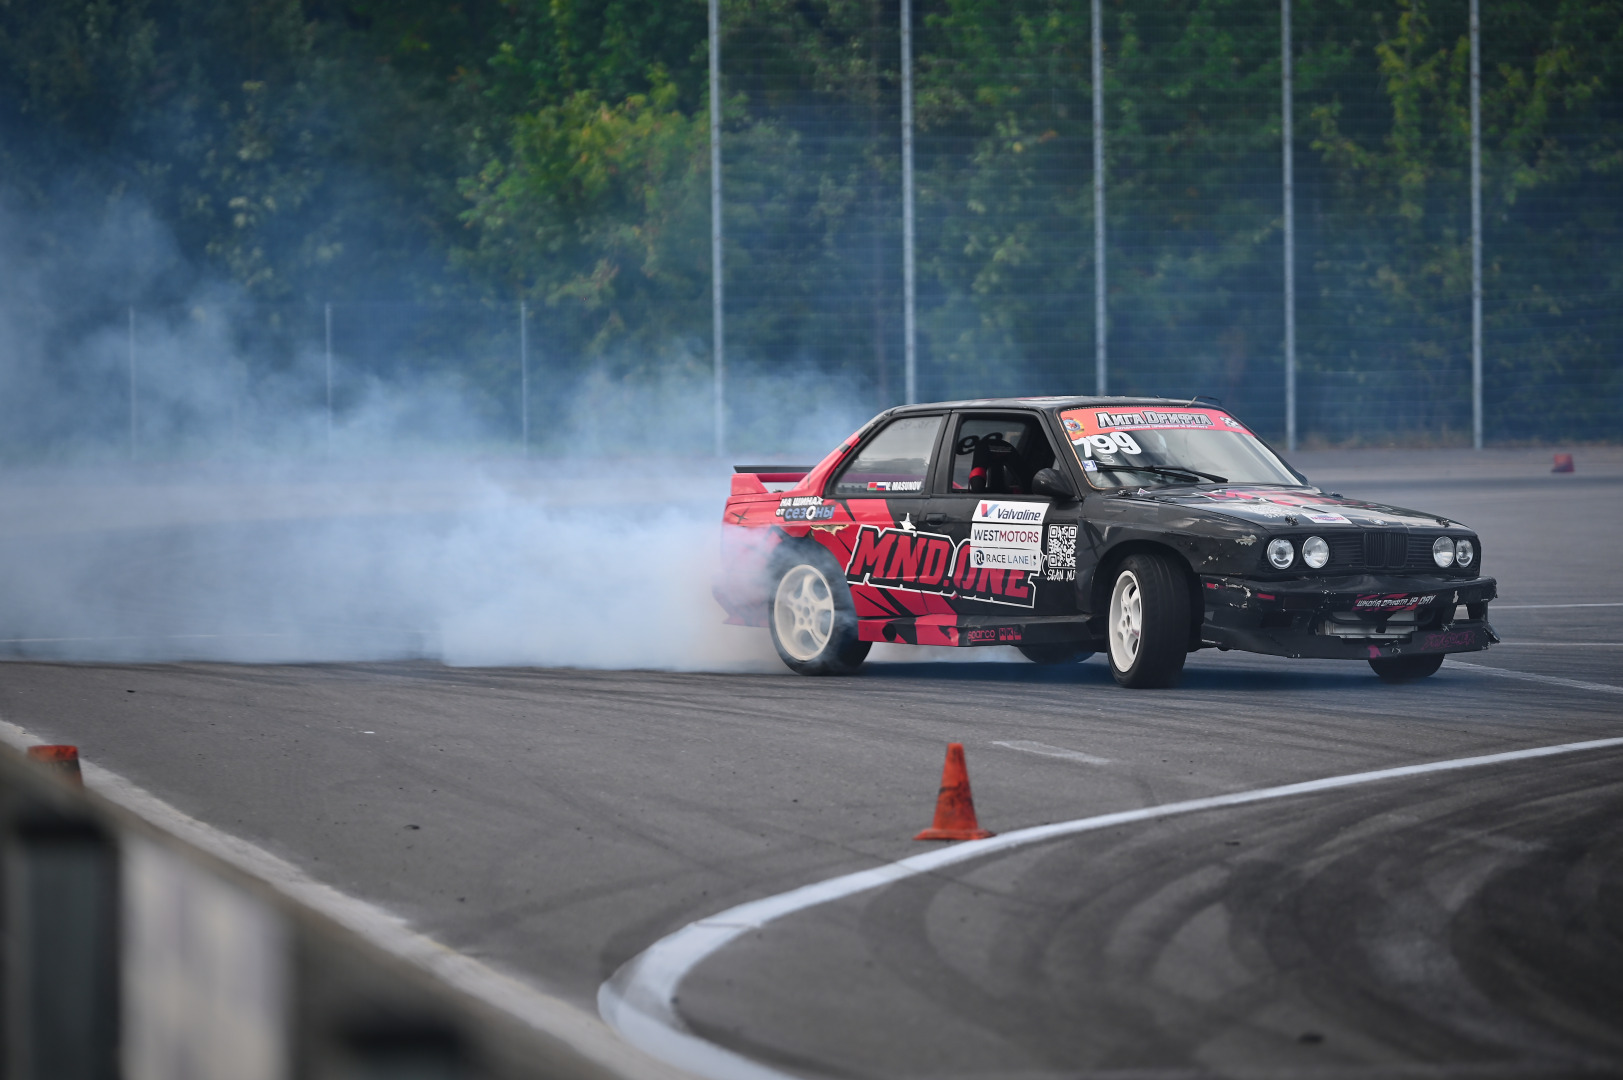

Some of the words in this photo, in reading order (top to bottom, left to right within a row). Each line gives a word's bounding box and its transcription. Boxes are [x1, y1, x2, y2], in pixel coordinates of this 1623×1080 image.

[1072, 432, 1142, 457] 799
[892, 481, 922, 491] MASUNOV
[780, 498, 791, 507] НА
[998, 508, 1041, 520] Valvoline
[974, 529, 1039, 543] WESTMOTORS
[986, 554, 1006, 563] RACE
[1008, 555, 1029, 565] LANE
[1418, 595, 1437, 605] DAY
[968, 629, 996, 640] sparco
